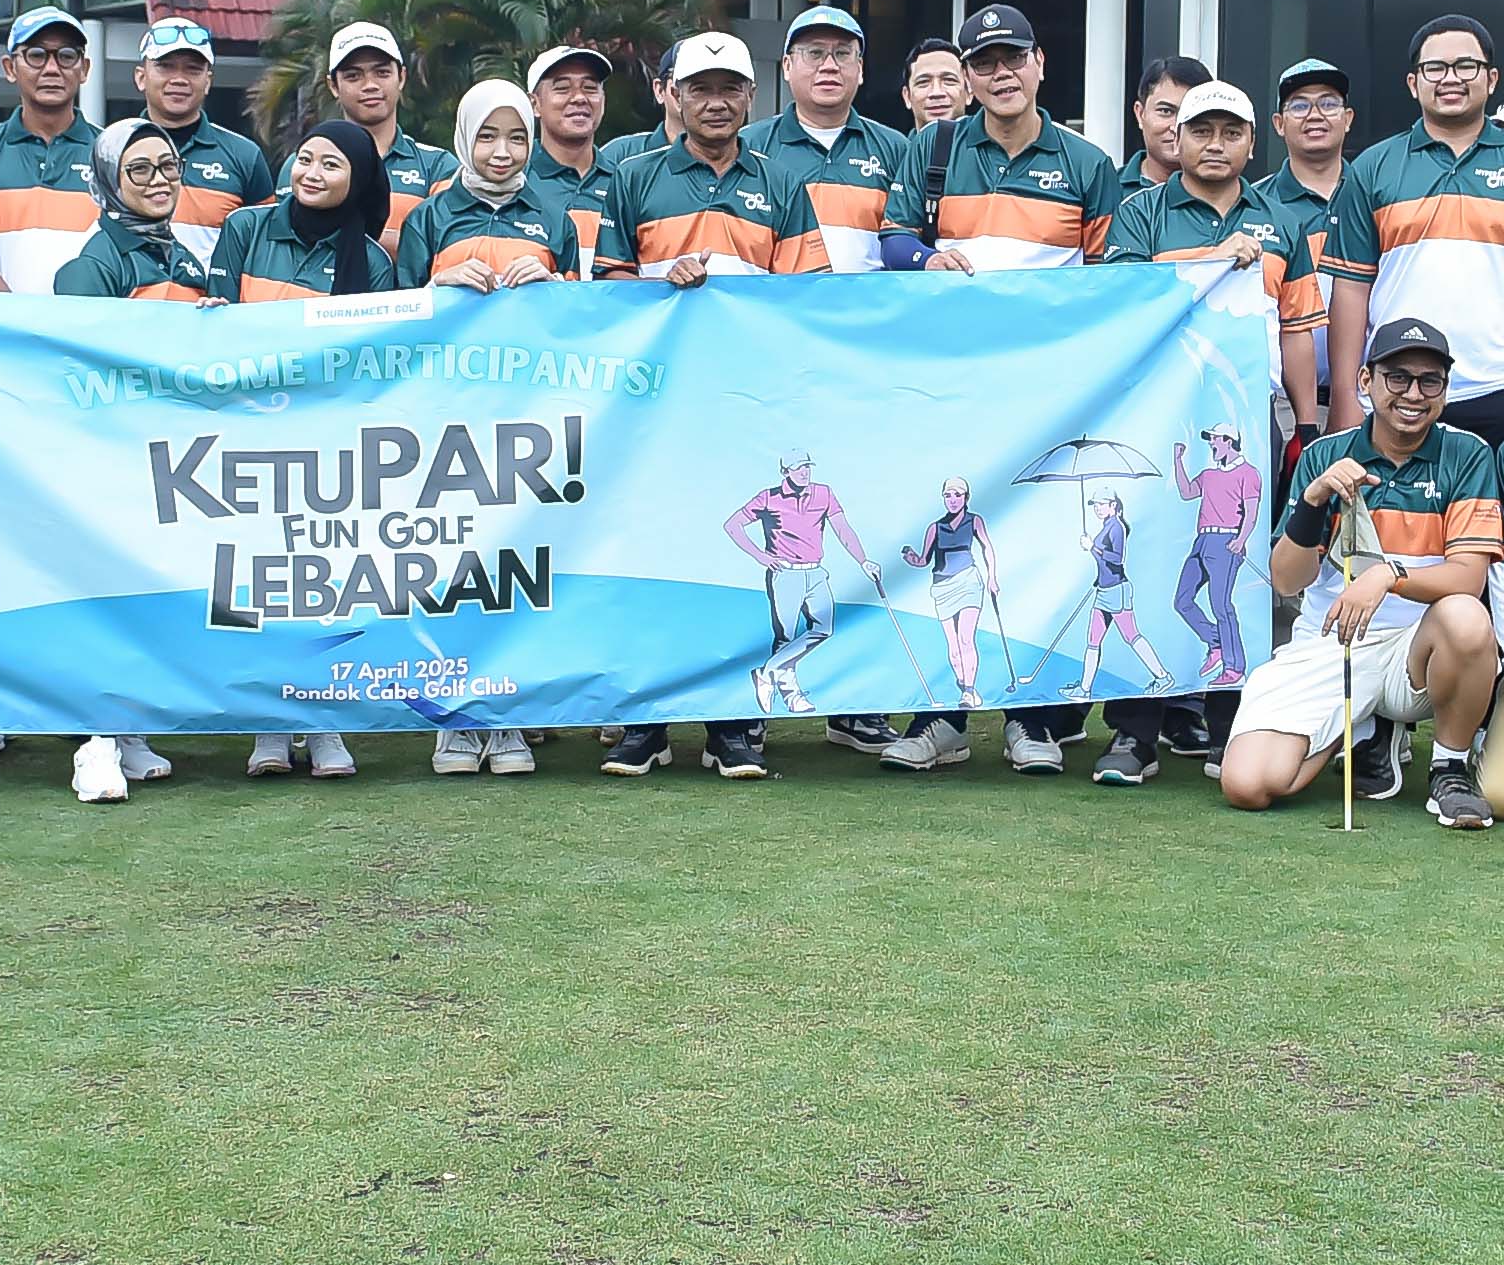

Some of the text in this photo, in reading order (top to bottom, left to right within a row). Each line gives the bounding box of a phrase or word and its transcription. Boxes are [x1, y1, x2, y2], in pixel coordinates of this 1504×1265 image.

[394, 303, 422, 313] GOLF
[64, 343, 665, 409] WELCOME PARTICIPANTS!
[281, 511, 474, 552] FUN GOLF
[210, 543, 551, 630] LEBARAN
[281, 675, 517, 701] Pondok Cabe Golf Club
[329, 656, 469, 685] 17 April 2025
